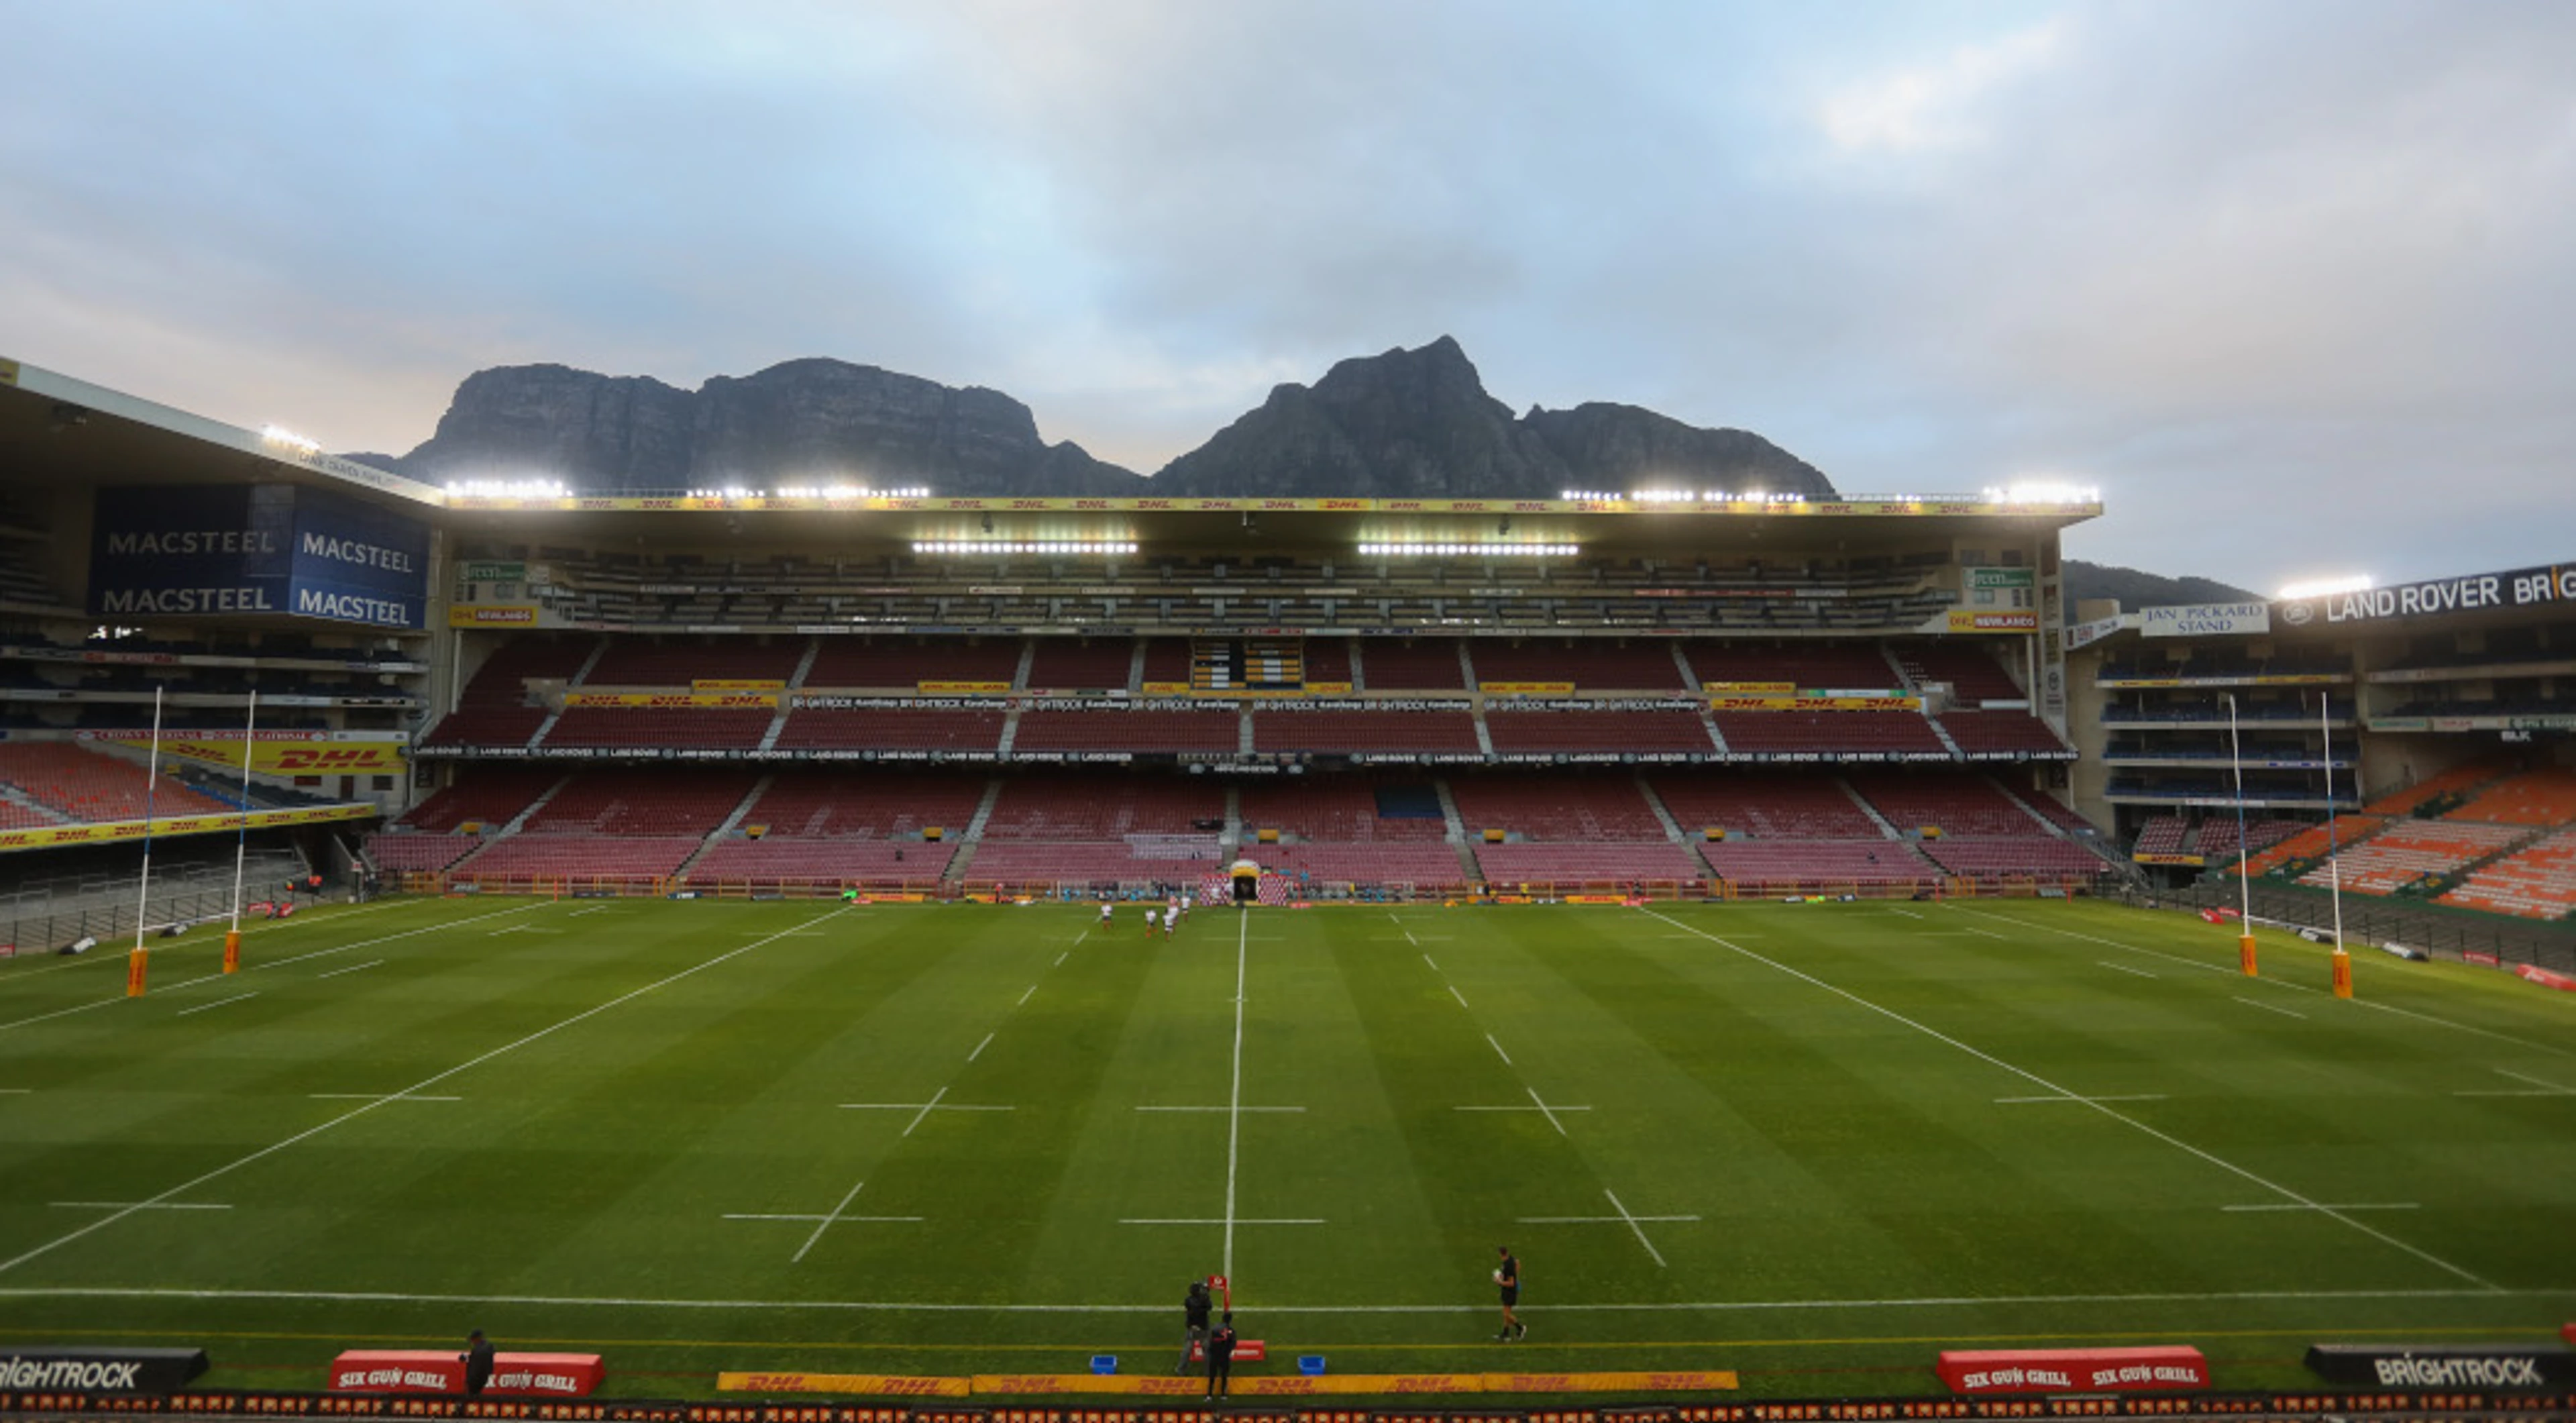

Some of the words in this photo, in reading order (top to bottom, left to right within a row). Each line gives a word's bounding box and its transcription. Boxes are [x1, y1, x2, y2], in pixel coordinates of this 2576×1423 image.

[109, 531, 275, 554] MACSTEEL
[303, 532, 413, 574] MACSTEEL
[104, 587, 272, 613] MACSTEEL
[299, 588, 410, 625] MACSTEEL
[2326, 588, 2396, 623] LAND
[2401, 576, 2500, 615] ROVER
[2147, 608, 2177, 622] JAN
[2186, 604, 2263, 619] PICKARD
[2178, 620, 2233, 632] STAND
[650, 696, 692, 705] DHL
[1724, 699, 1765, 708] DHL
[1796, 699, 1837, 708] DHL
[1865, 698, 1905, 707] DHL
[278, 750, 386, 769] DHL
[338, 1372, 366, 1387] SIX
[368, 1367, 402, 1387] GUN
[404, 1371, 447, 1389] GRILL
[1962, 1371, 1990, 1388] SIX
[1991, 1366, 2024, 1387] GUN
[2026, 1369, 2072, 1387] GRILL
[2092, 1370, 2118, 1386] SIX
[2119, 1364, 2152, 1383] GUN
[2154, 1366, 2199, 1383] GRILL
[2374, 1351, 2544, 1385] BRIGHTROCK
[498, 1369, 531, 1389] GUN
[534, 1373, 577, 1391] GRILL
[747, 1375, 806, 1391] DHL
[883, 1378, 941, 1394] DHL
[1002, 1378, 1061, 1393] DHL
[1138, 1379, 1199, 1394] DHL
[1256, 1379, 1314, 1394] DHL
[1395, 1377, 1453, 1393] DHL
[1511, 1376, 1568, 1391] DHL
[1648, 1373, 1706, 1389] DHL
